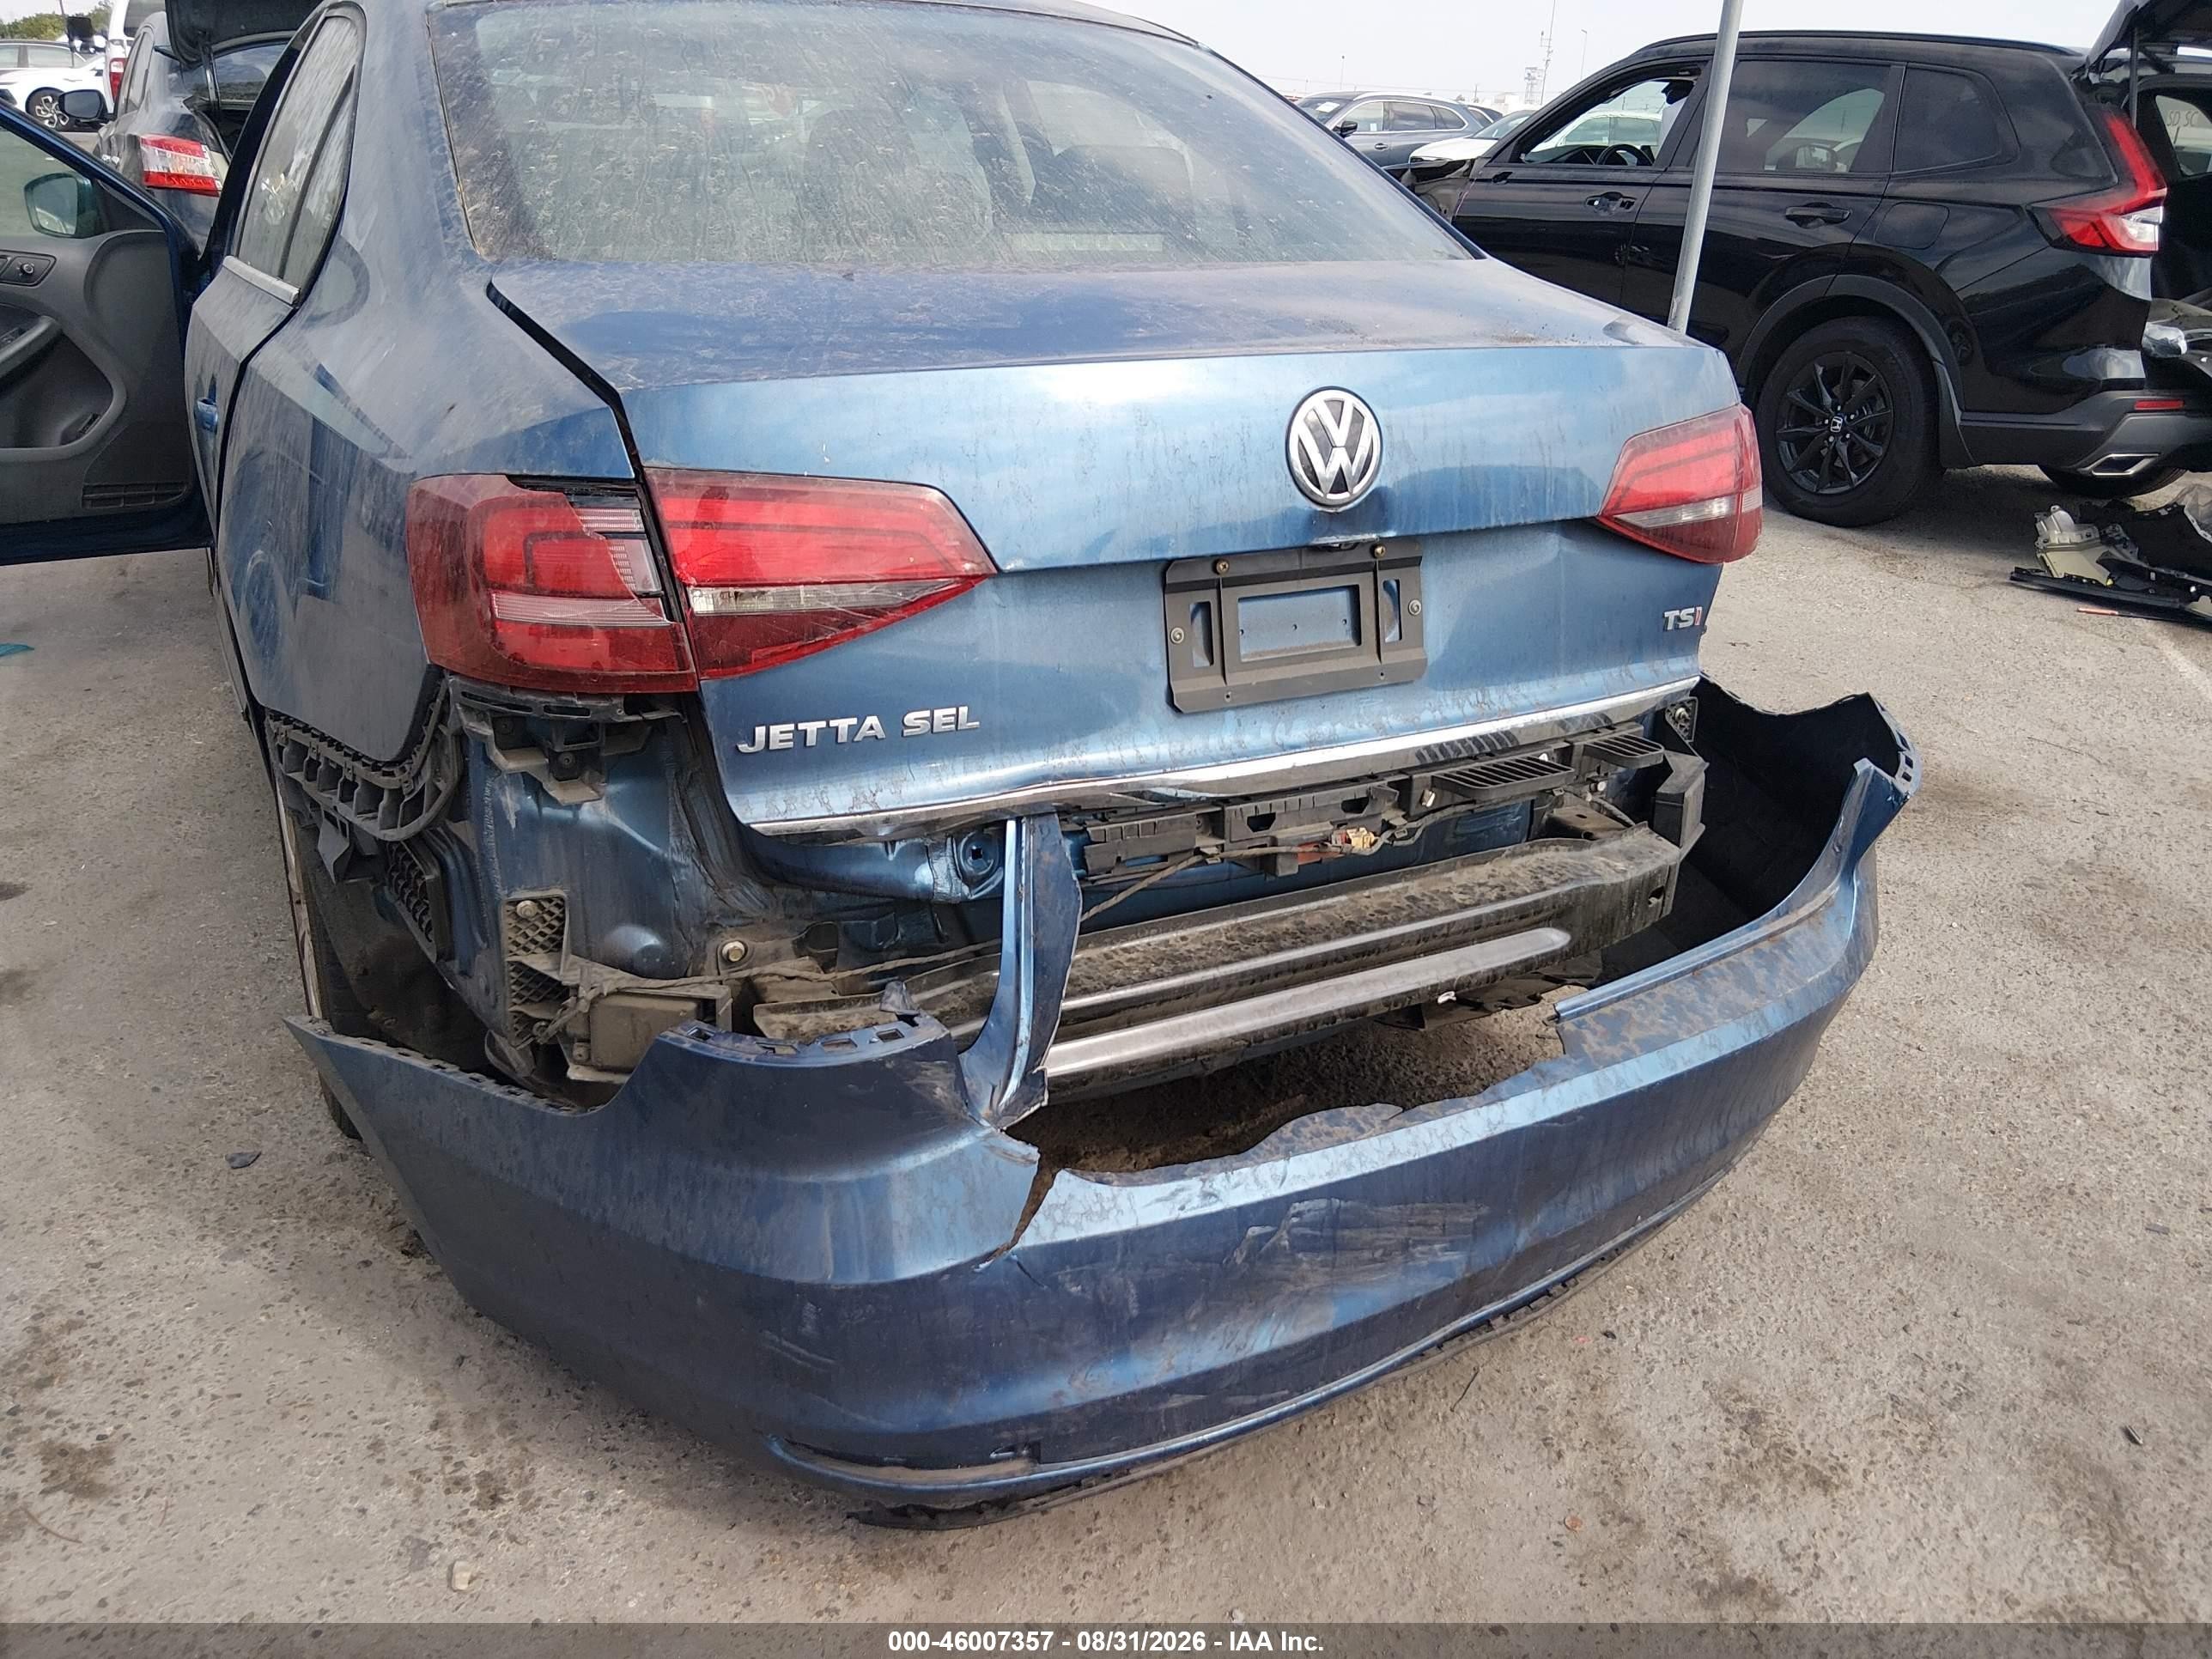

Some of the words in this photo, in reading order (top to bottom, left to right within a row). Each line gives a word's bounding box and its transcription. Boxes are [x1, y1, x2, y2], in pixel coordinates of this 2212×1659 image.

[1291, 391, 1379, 501] VW
[736, 715, 886, 754] JETTA
[902, 706, 980, 736] SEL
